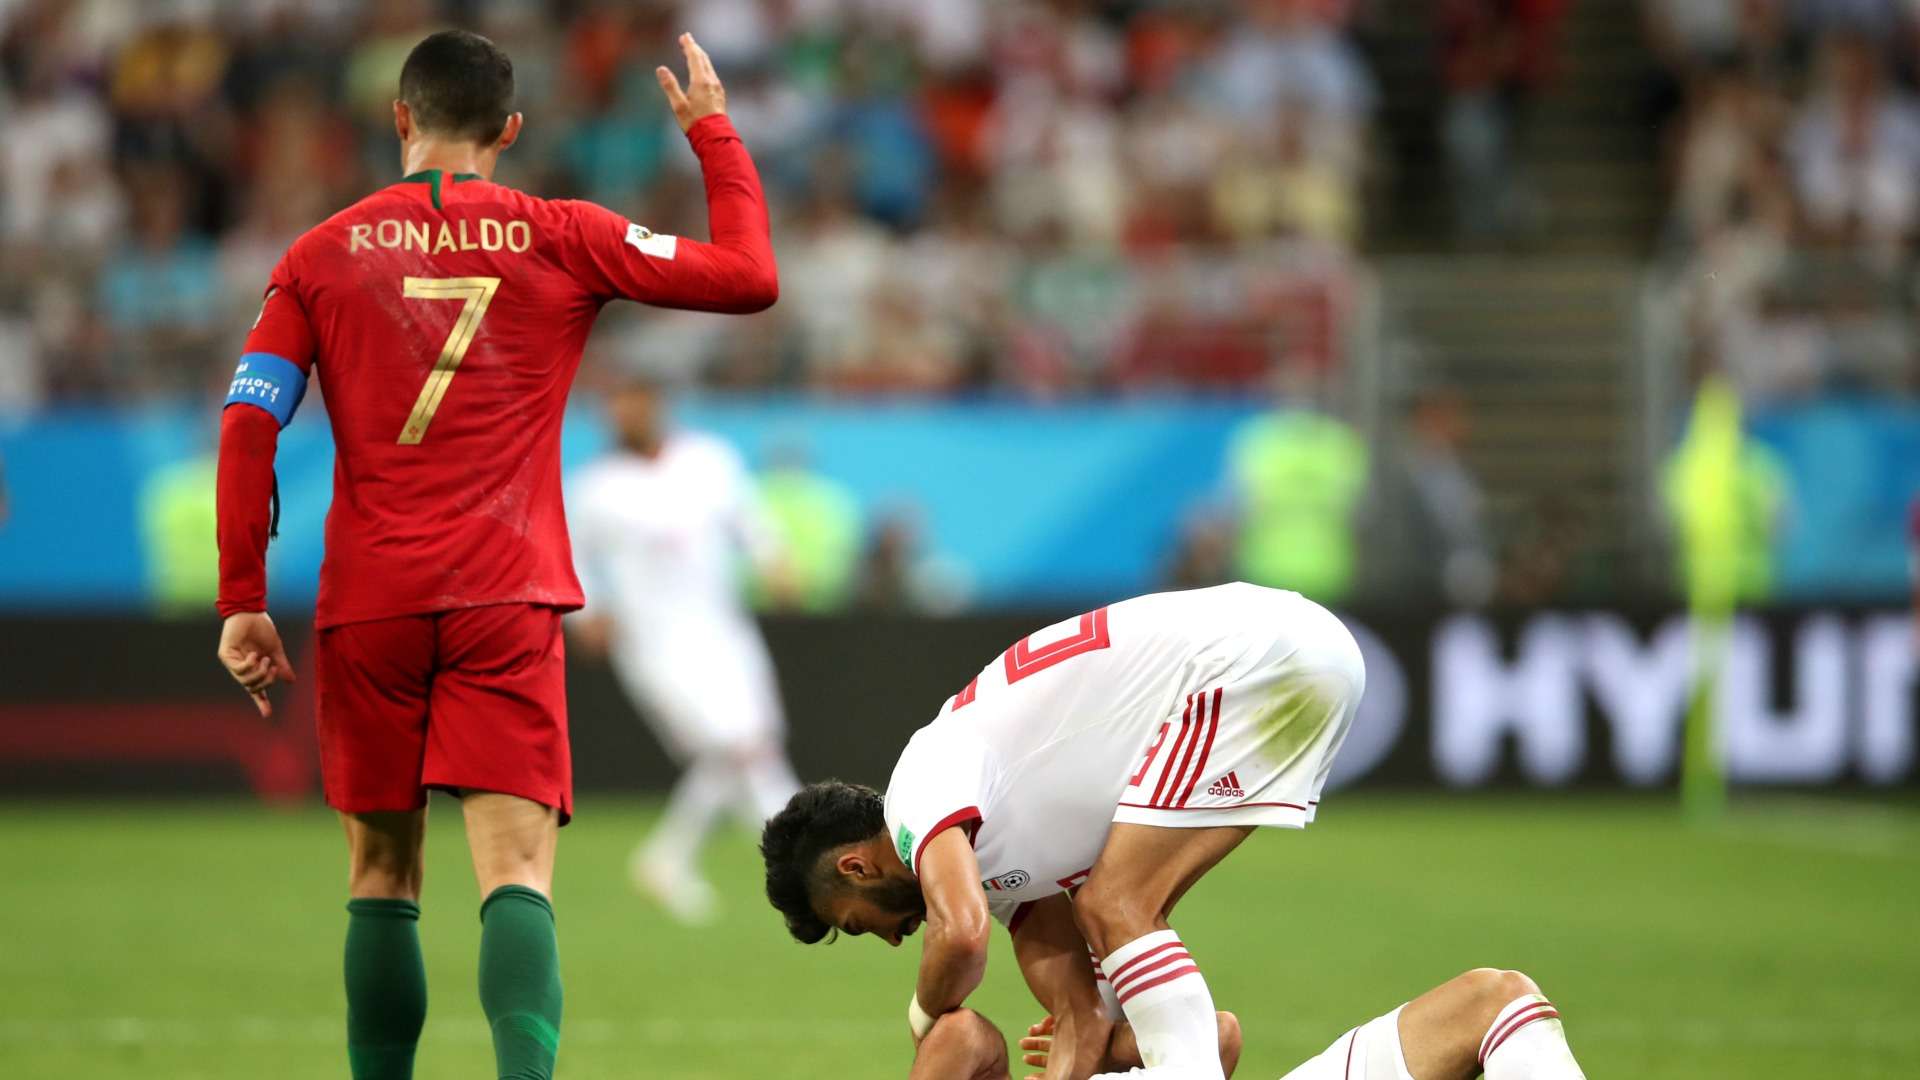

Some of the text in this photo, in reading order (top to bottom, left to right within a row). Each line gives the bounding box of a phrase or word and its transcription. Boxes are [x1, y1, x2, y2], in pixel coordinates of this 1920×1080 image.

[350, 218, 531, 255] RONALDO
[397, 276, 501, 444] 7
[1208, 786, 1245, 797] adidas
